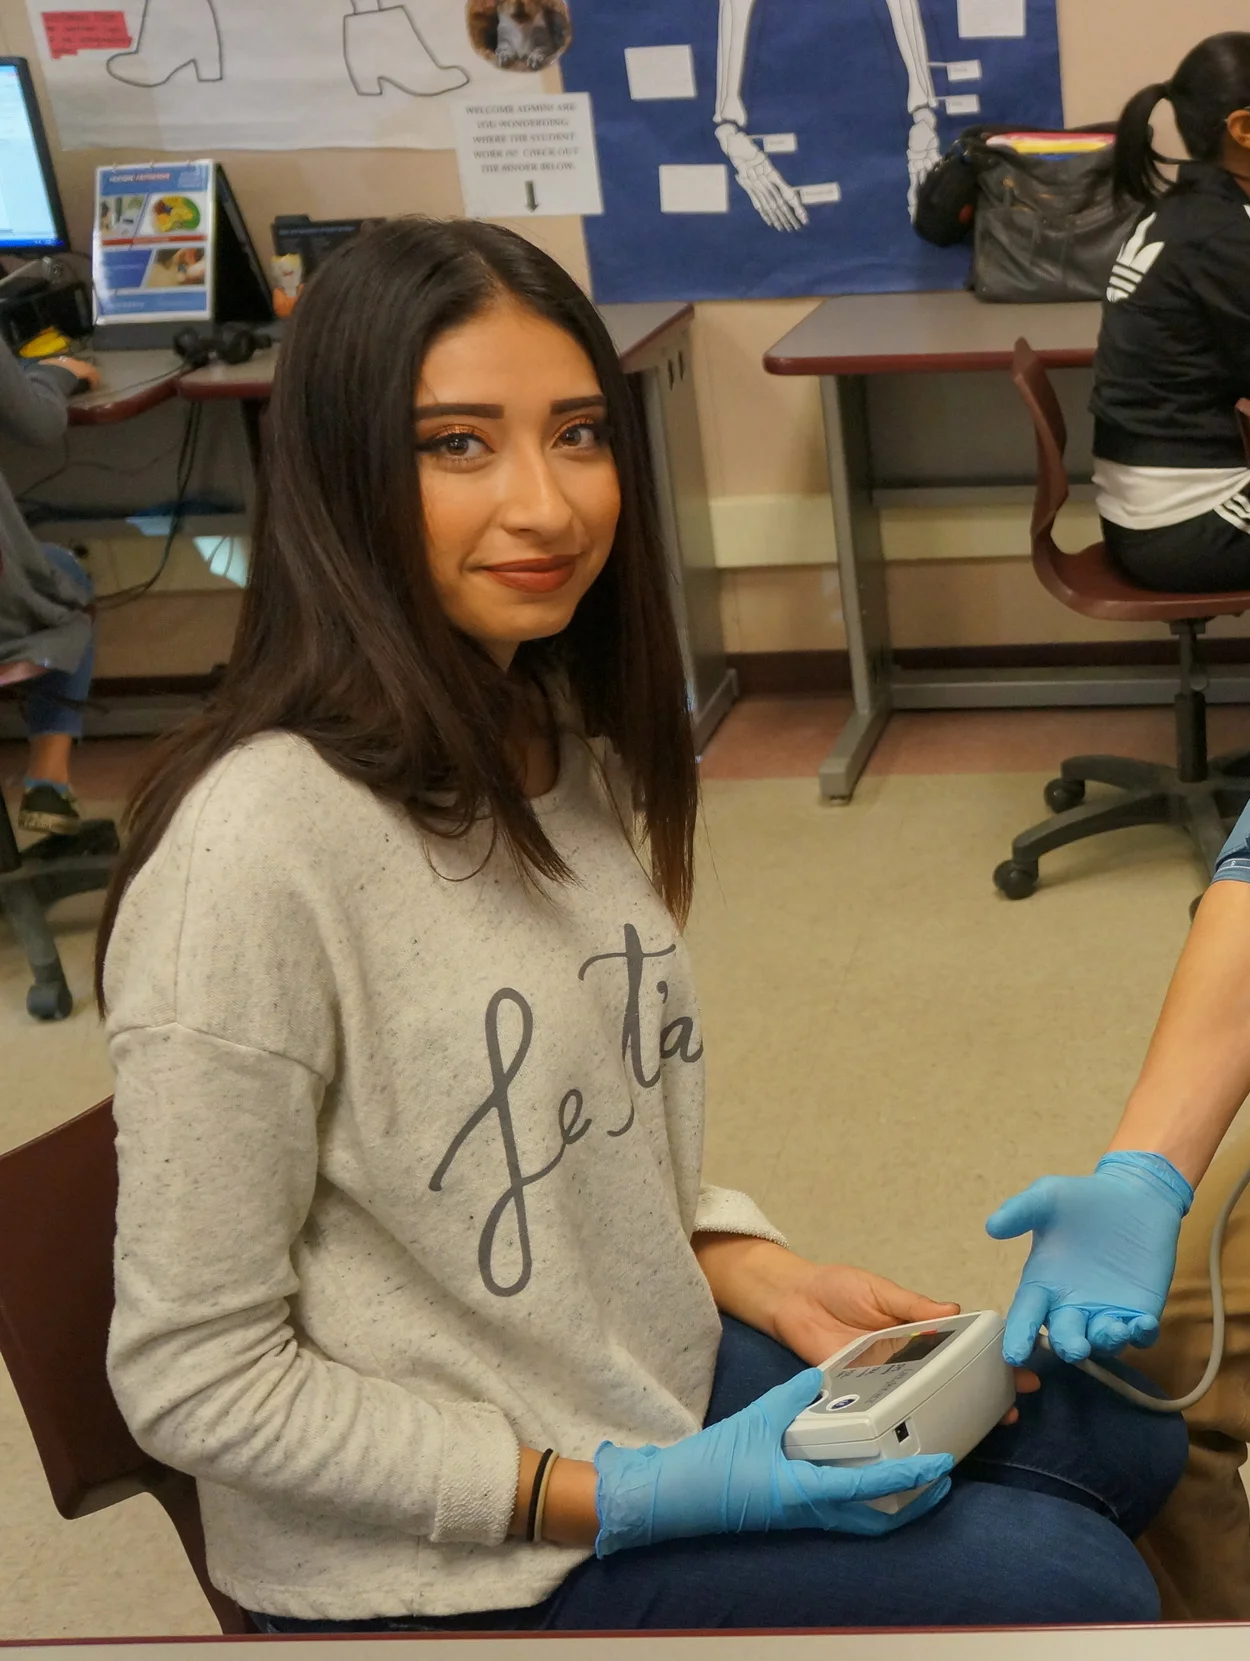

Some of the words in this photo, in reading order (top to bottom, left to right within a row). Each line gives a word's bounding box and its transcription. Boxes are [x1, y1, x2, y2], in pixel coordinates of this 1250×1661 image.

[466, 104, 514, 115] WELCOME
[556, 102, 577, 112] ARE
[476, 120, 496, 129] YOU
[472, 134, 507, 144] WHERE
[510, 134, 527, 142] THE
[530, 132, 576, 142] STUDENT
[473, 149, 503, 159] WORK
[522, 148, 556, 157] CHECK
[557, 147, 579, 156] OUT
[481, 164, 499, 173] THE
[501, 163, 537, 172] BINDER
[578, 923, 704, 1137] t'a
